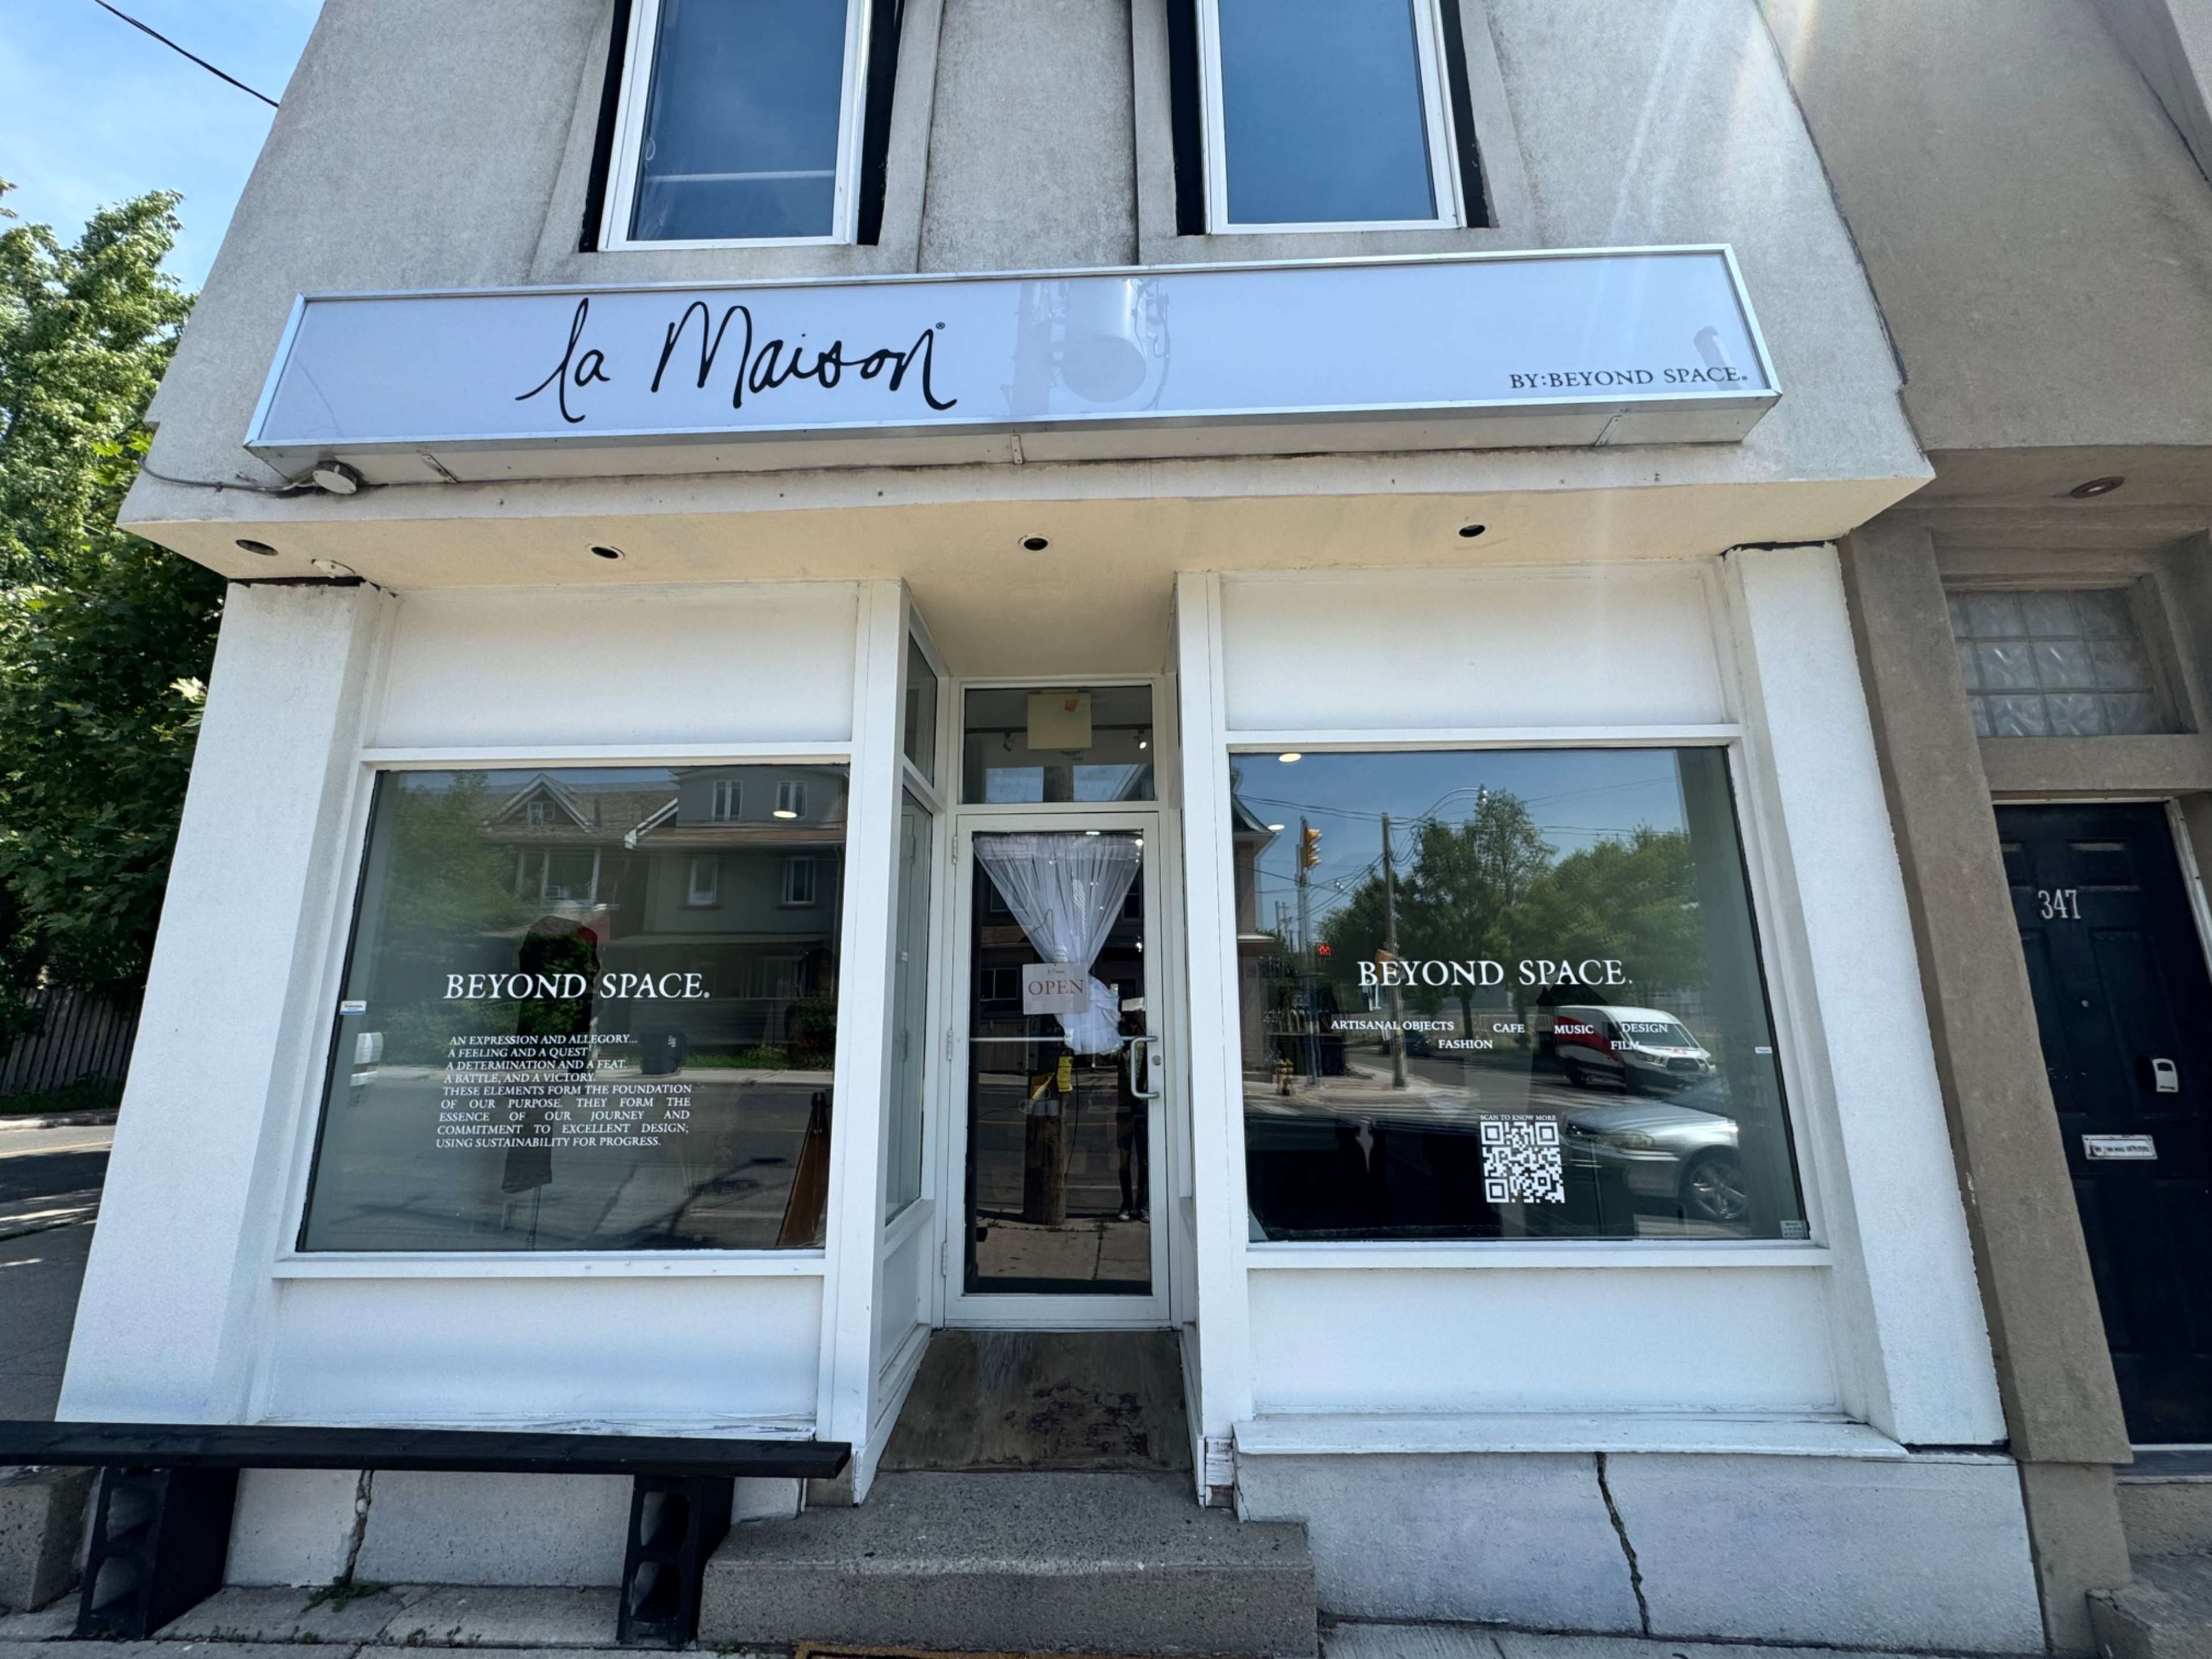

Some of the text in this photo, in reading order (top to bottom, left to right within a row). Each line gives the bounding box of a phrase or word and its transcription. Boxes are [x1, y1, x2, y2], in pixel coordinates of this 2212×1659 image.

[1664, 366, 1748, 384] SPACE.
[2038, 889, 2081, 919] 347
[1357, 959, 1633, 986] BEYOND SPACE.
[442, 972, 711, 1000] BEYOND SPACE.
[1028, 979, 1084, 996] OPEN
[1331, 1020, 1455, 1032] ARTISANAL OBJECTS
[1493, 1023, 1525, 1033] CAFE
[1554, 1024, 1594, 1035] MUSIC
[1622, 1022, 1668, 1033] DESIGN
[449, 1035, 638, 1045] AN EXPRESSION AND ALLEGORY...
[1438, 1039, 1493, 1050] FASHION
[1611, 1041, 1639, 1050] FILM
[448, 1048, 455, 1058] A
[459, 1048, 508, 1057] FEELING
[510, 1048, 536, 1056] AND
[538, 1048, 546, 1056] A
[446, 1061, 454, 1070] A
[457, 1060, 556, 1070] DETERMINATION
[558, 1060, 584, 1069] AND
[586, 1059, 594, 1069] A
[444, 1074, 452, 1083] A
[455, 1074, 501, 1084] BATTLE,
[503, 1073, 529, 1082] AND
[532, 1073, 540, 1082] A
[443, 1084, 692, 1096] THESE ELEMENTS FORM THE FOUNDATION
[441, 1100, 457, 1109] OF
[469, 1099, 495, 1108] OUR
[577, 1098, 608, 1107] THEY
[619, 1097, 654, 1107] FORM
[666, 1097, 691, 1106] THE
[439, 1110, 690, 1122] ESSENCE OF OUR JOURNEY AND
[437, 1123, 689, 1134] COMMITMENT TO EXCELLENT DESIGN;
[436, 1136, 661, 1147] USING SUSTAINABILITY FOR PROGRESS.
